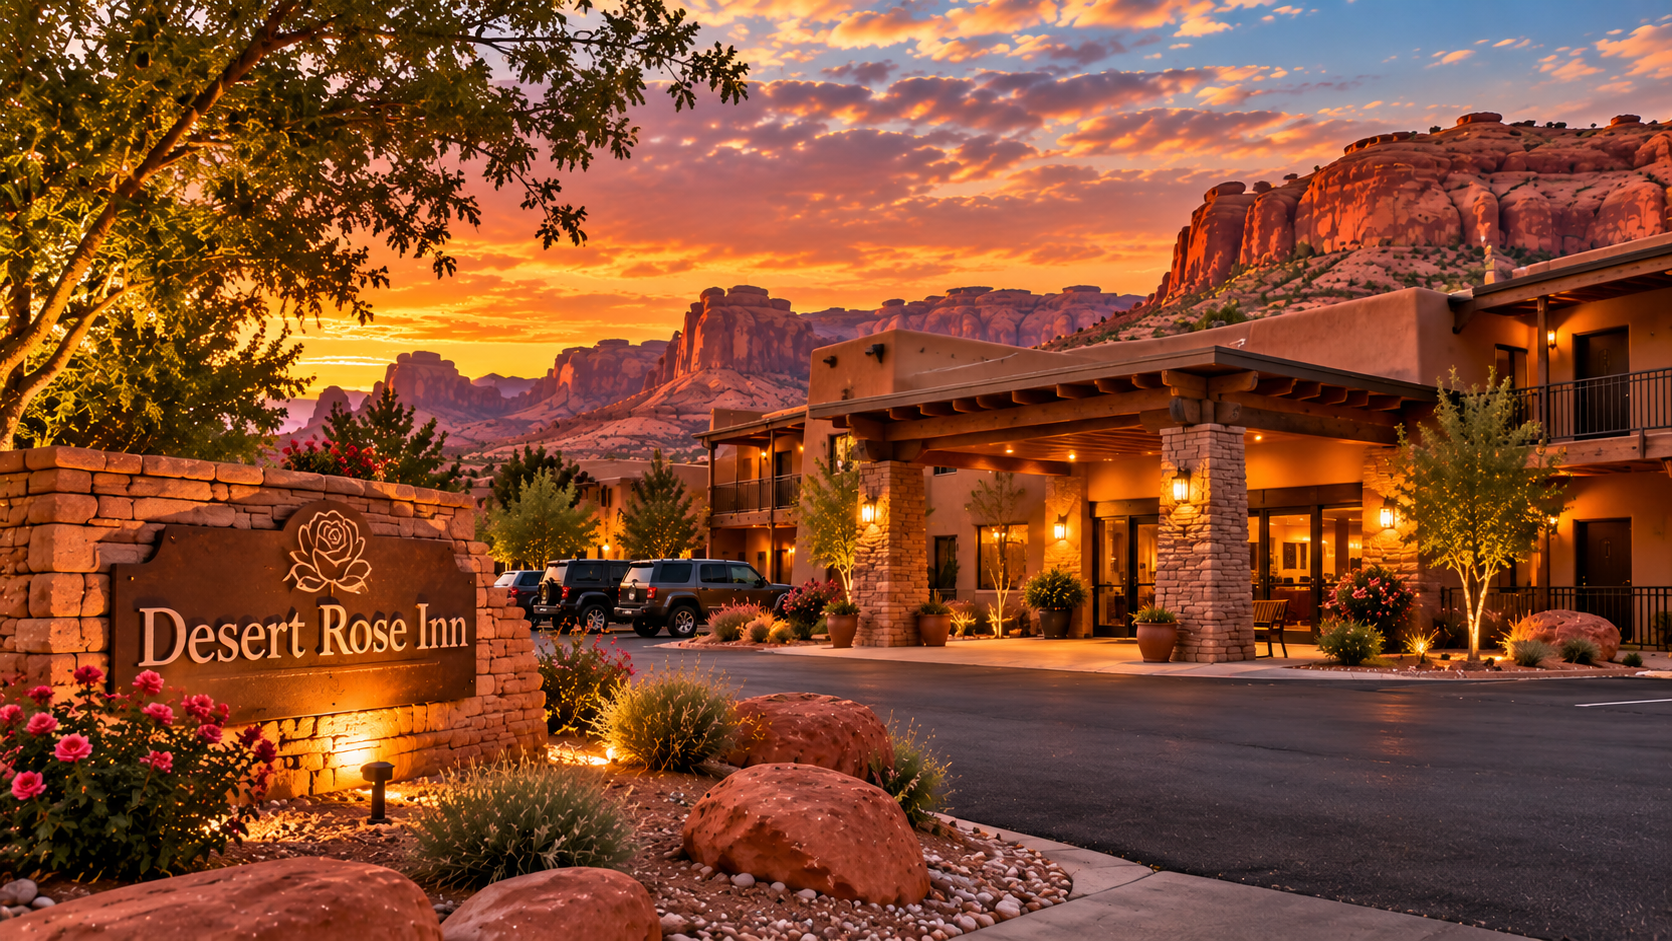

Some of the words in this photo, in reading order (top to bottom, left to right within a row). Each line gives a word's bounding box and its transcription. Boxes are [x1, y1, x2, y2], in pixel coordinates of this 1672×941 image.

[138, 607, 306, 667] Desert
[318, 604, 407, 656] Rose
[416, 602, 469, 650] Inn
